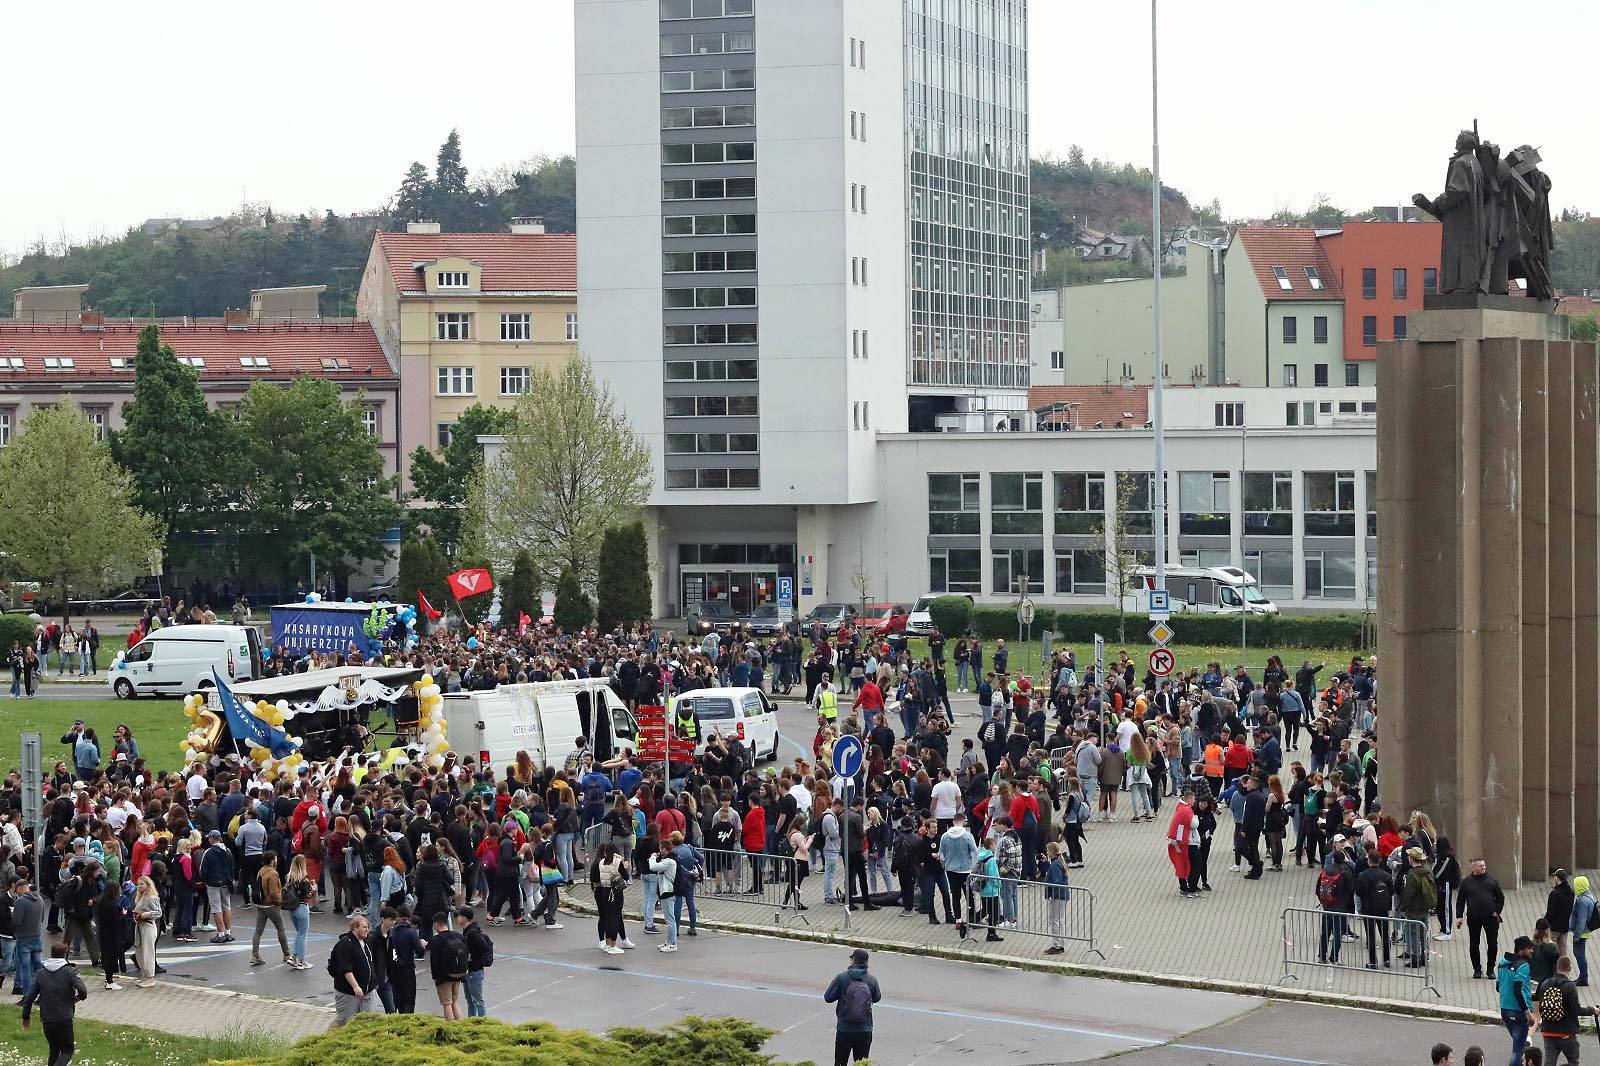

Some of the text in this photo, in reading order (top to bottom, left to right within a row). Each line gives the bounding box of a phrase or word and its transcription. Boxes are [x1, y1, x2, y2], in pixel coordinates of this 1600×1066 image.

[782, 580, 790, 593] P
[284, 623, 354, 637] MASARYKOVA
[284, 637, 353, 650] UNIVERZITA
